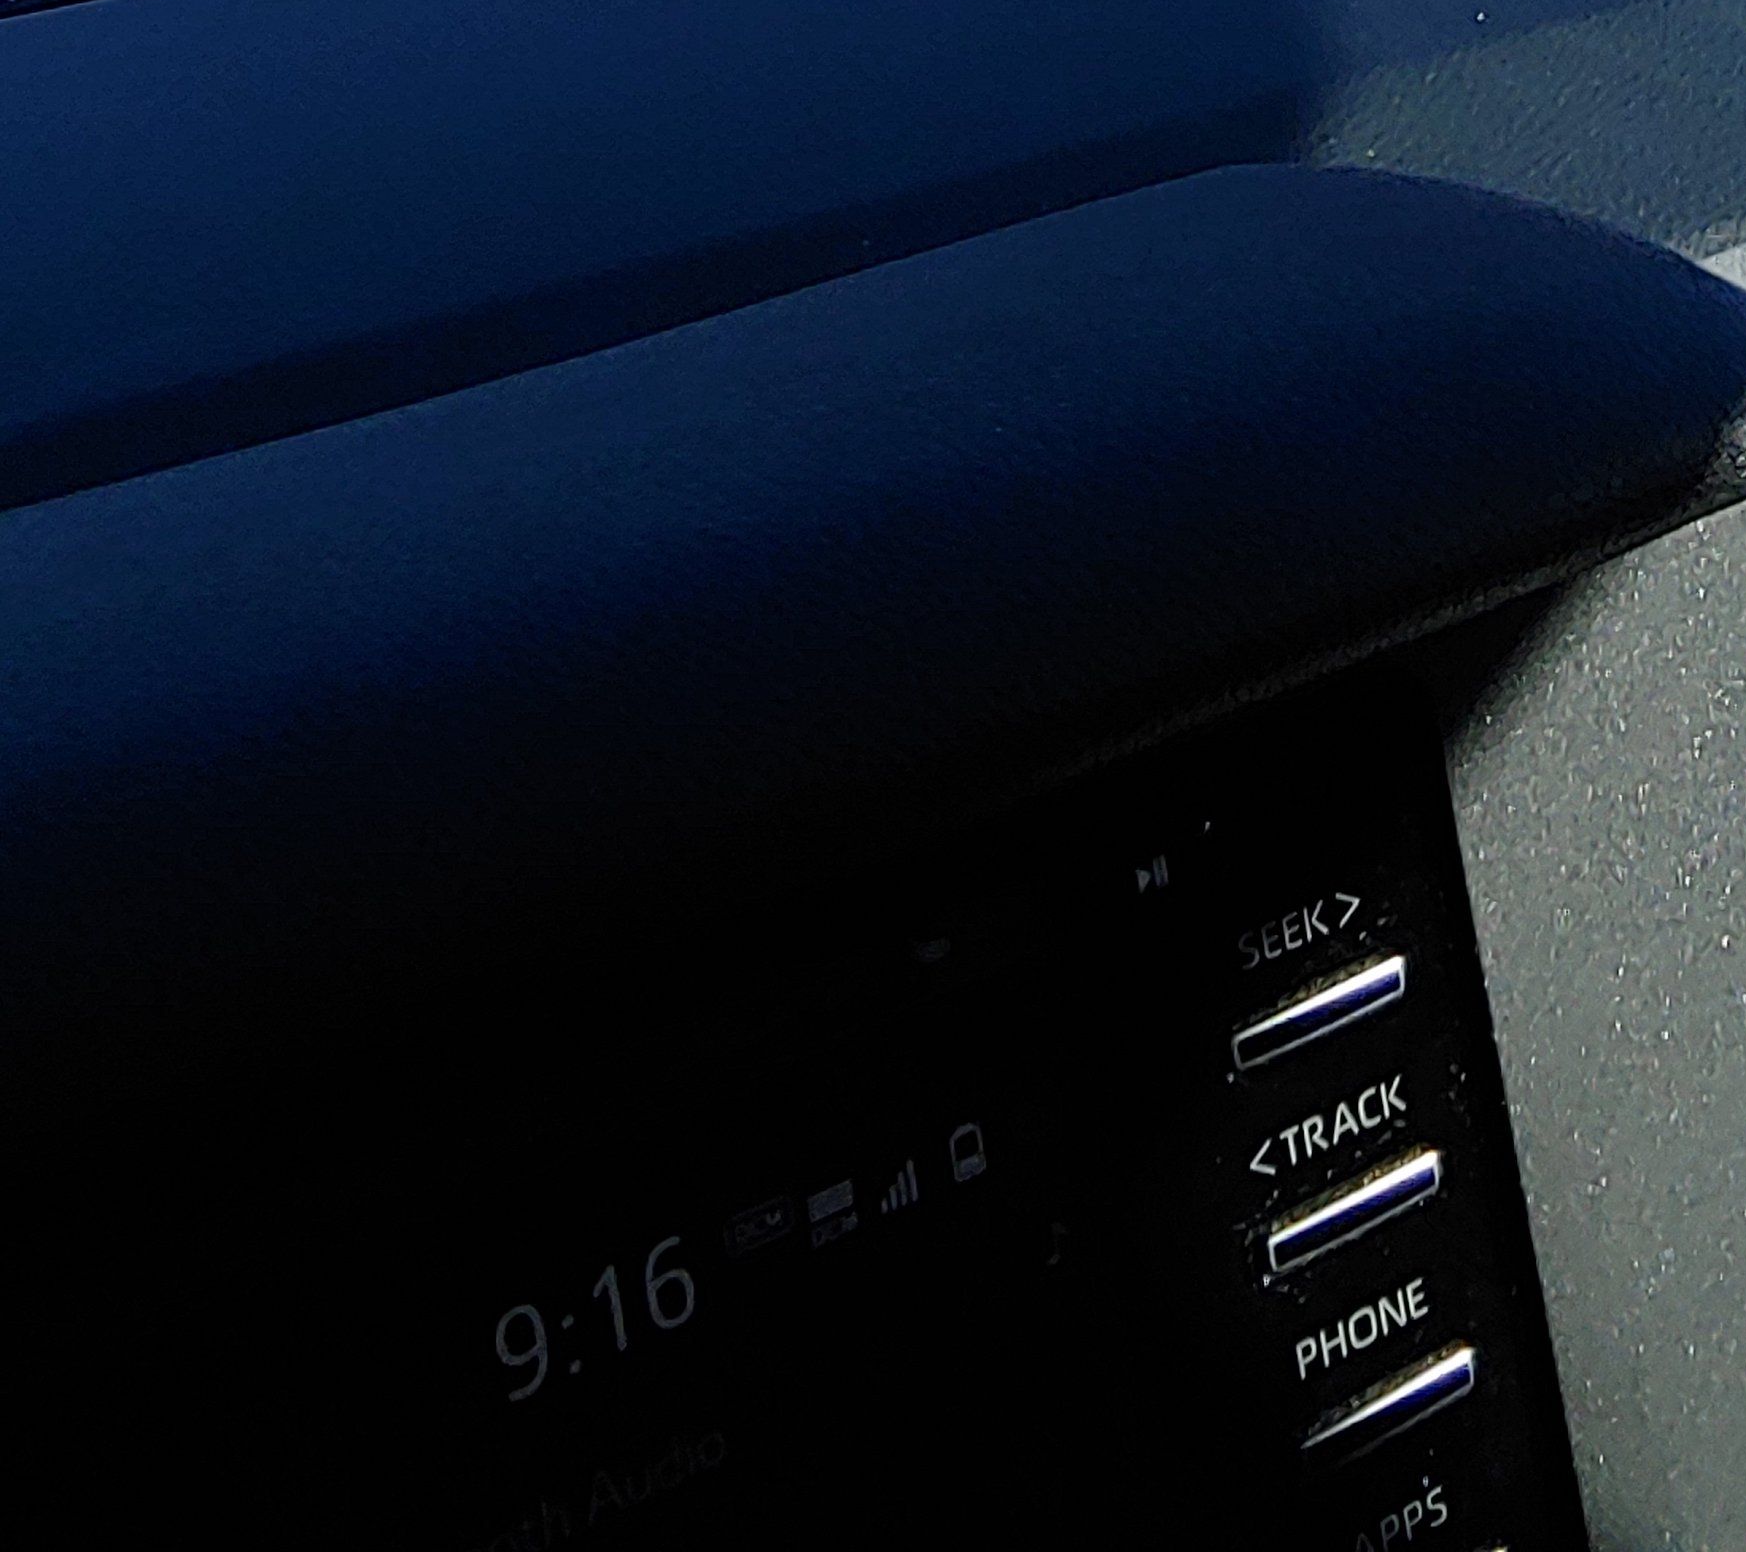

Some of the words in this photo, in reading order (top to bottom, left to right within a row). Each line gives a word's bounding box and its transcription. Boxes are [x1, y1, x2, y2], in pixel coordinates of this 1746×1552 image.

[494, 1234, 697, 1403] 9:16
[1294, 1276, 1431, 1382] PHONE
[1354, 1483, 1449, 1552] APPS
